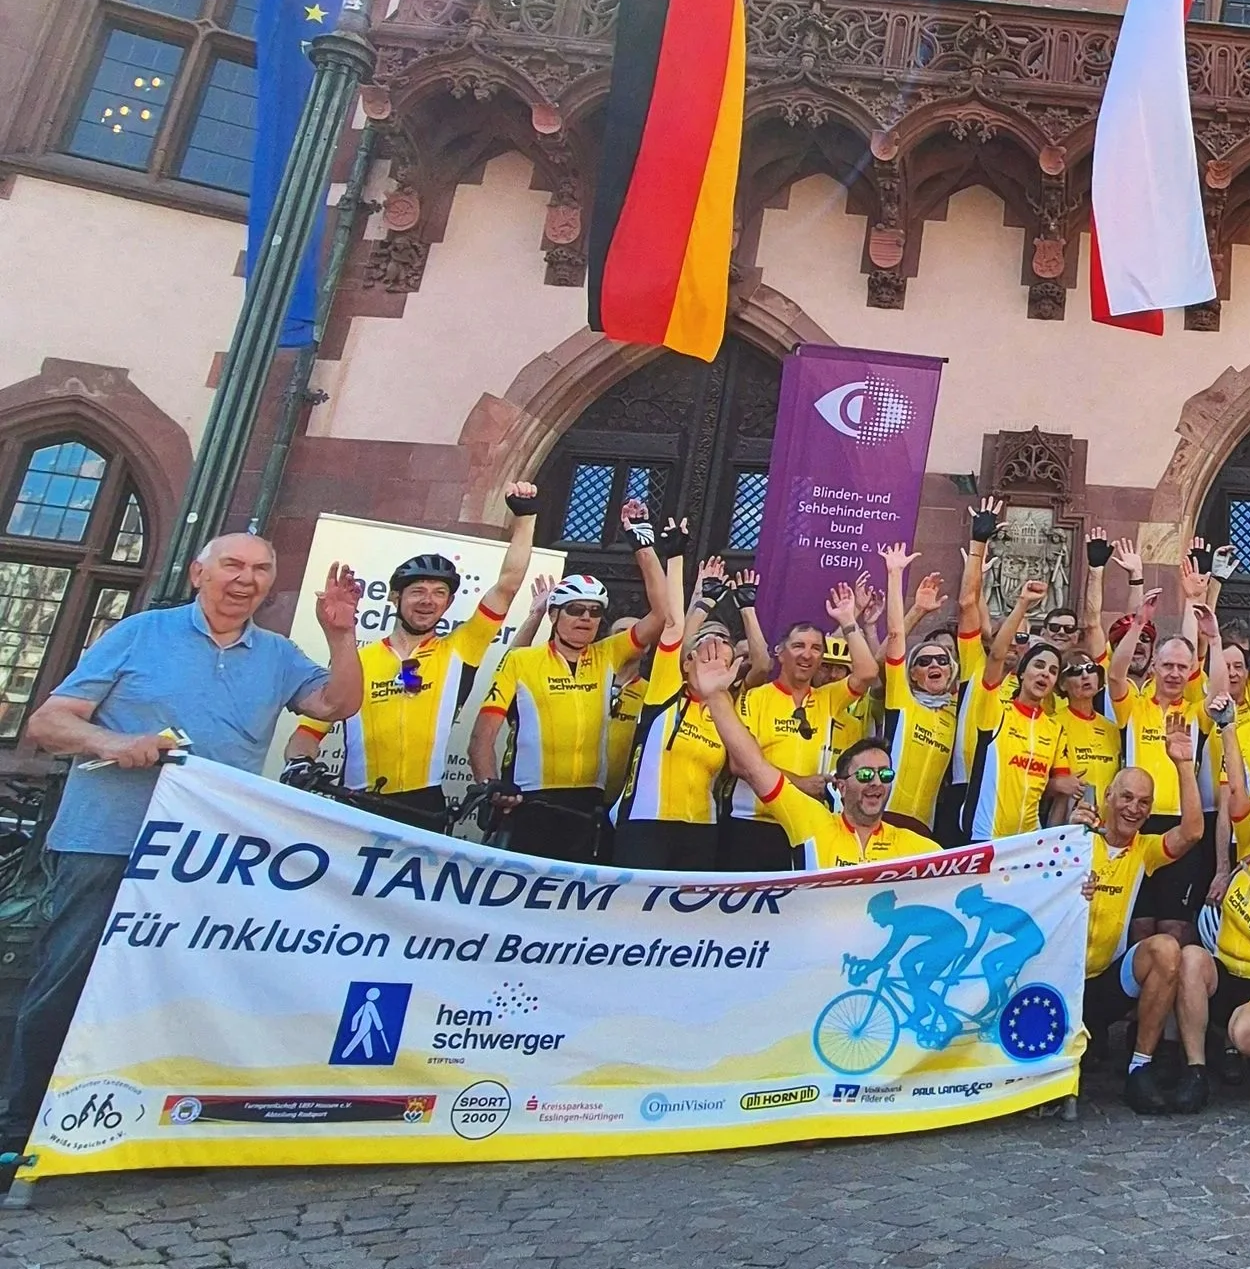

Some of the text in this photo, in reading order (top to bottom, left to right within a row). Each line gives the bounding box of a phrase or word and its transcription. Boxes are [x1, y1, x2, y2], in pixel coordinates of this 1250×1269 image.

[813, 486, 891, 505] Blinden- und
[798, 501, 901, 522] Sehbehinderten-
[830, 520, 863, 536] bund
[799, 534, 810, 547] in
[814, 537, 857, 552] Hessen
[861, 542, 872, 553] e.
[820, 554, 863, 571] (BSBH)
[124, 820, 330, 892] EURO
[351, 846, 621, 911] TANDEM
[873, 853, 987, 883] DANKE
[102, 912, 770, 969] Für Inklusion und Barrierefreiheit
[436, 1004, 493, 1027] hem
[432, 1028, 566, 1055] schwerger
[864, 1084, 902, 1094] Volksbank
[912, 1087, 936, 1096] PAUL
[460, 1097, 507, 1107] SPORT
[763, 1090, 798, 1106] HORN
[861, 1094, 895, 1104] Filder eG
[541, 1102, 603, 1112] Kreissparkasse
[461, 1113, 497, 1123] 2000
[539, 1113, 624, 1123] Esslingen-Nürtingen
